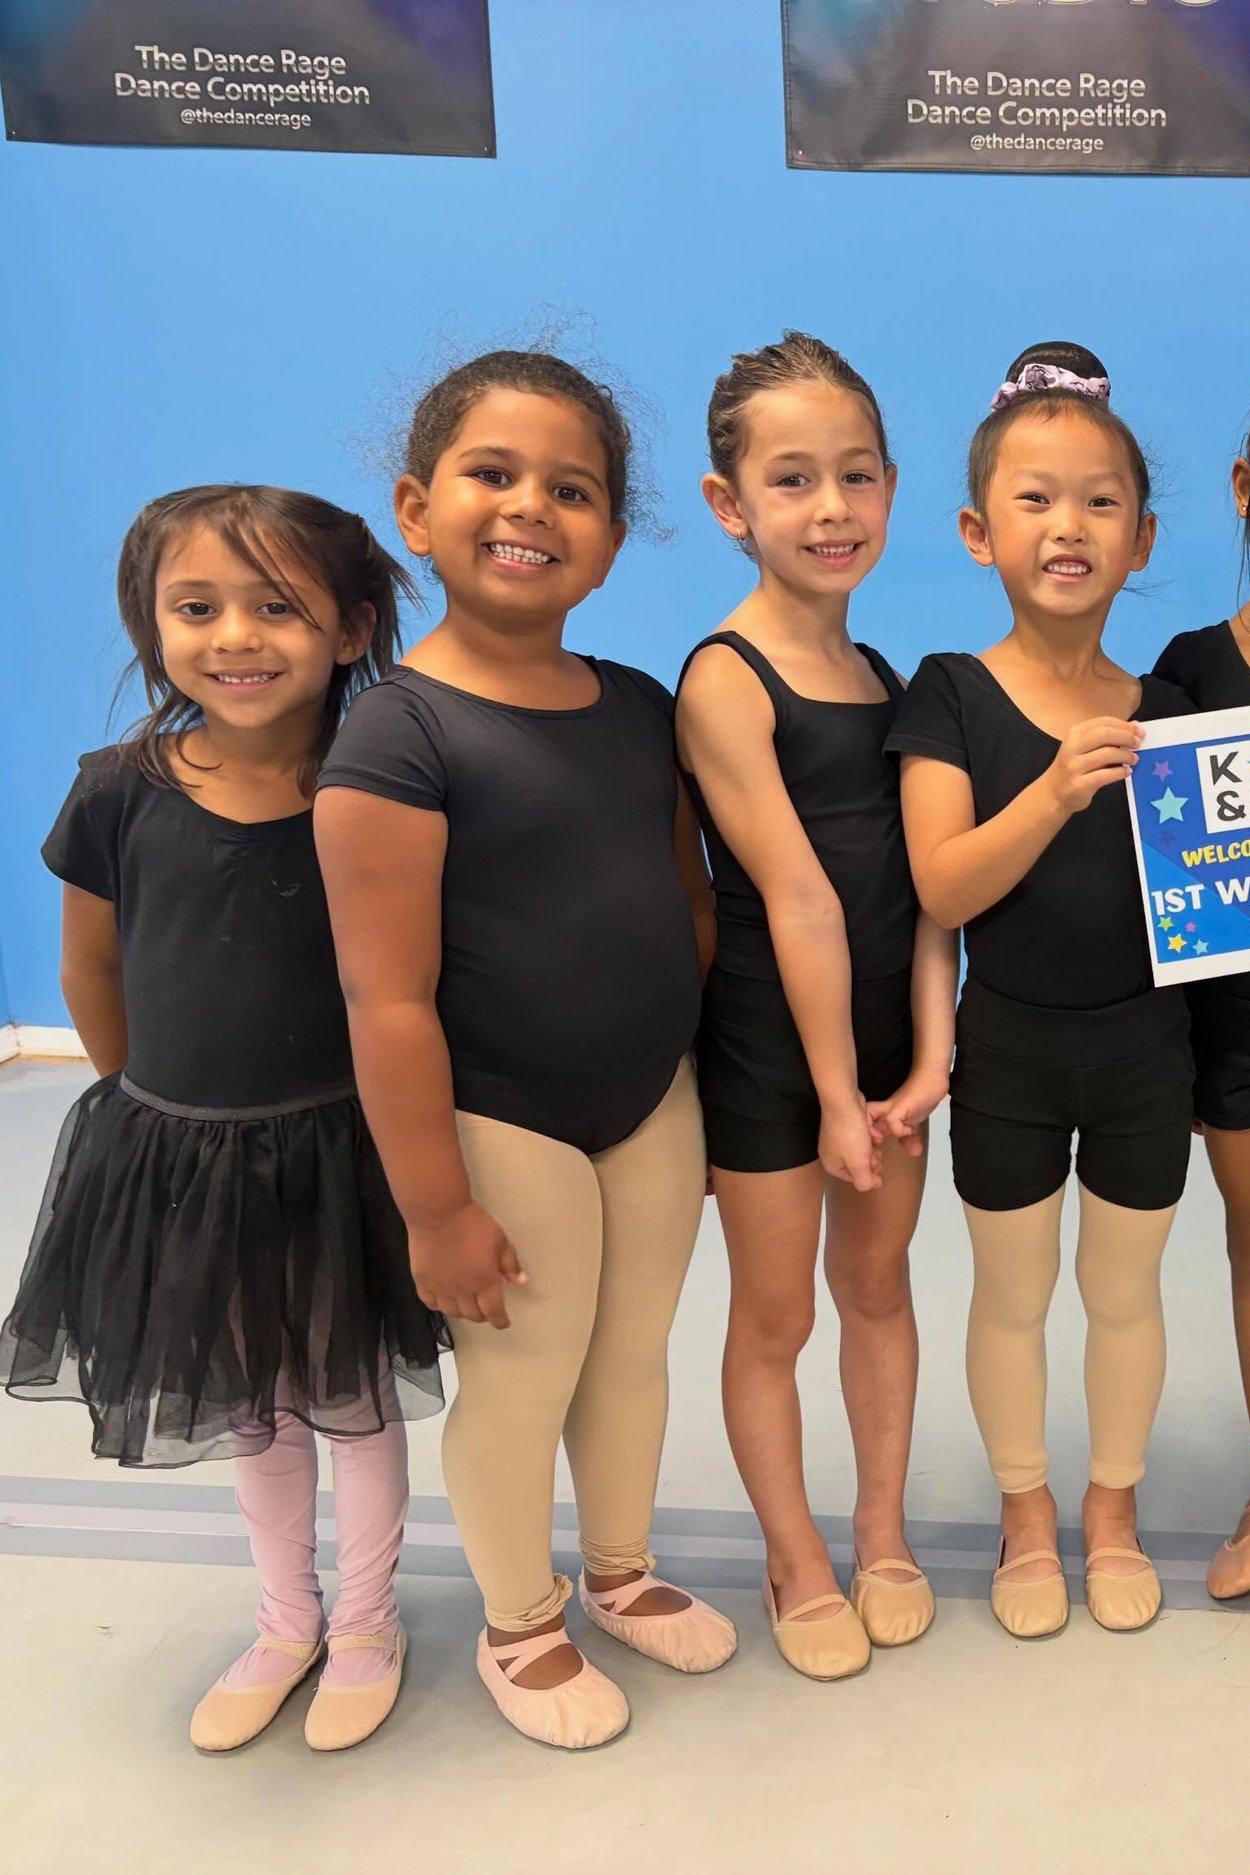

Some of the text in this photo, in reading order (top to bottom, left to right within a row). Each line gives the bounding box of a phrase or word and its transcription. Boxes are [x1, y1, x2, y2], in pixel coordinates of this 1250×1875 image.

[134, 45, 347, 80] The Dance Rage
[114, 72, 371, 108] Dance Competition
[928, 69, 1146, 103] The Dance Rage
[180, 107, 312, 130] @thedancerage
[907, 98, 1167, 132] Dance Competition
[970, 132, 1104, 154] @thedancerage
[1209, 751, 1243, 786] K
[1151, 883, 1205, 916] 1ST
